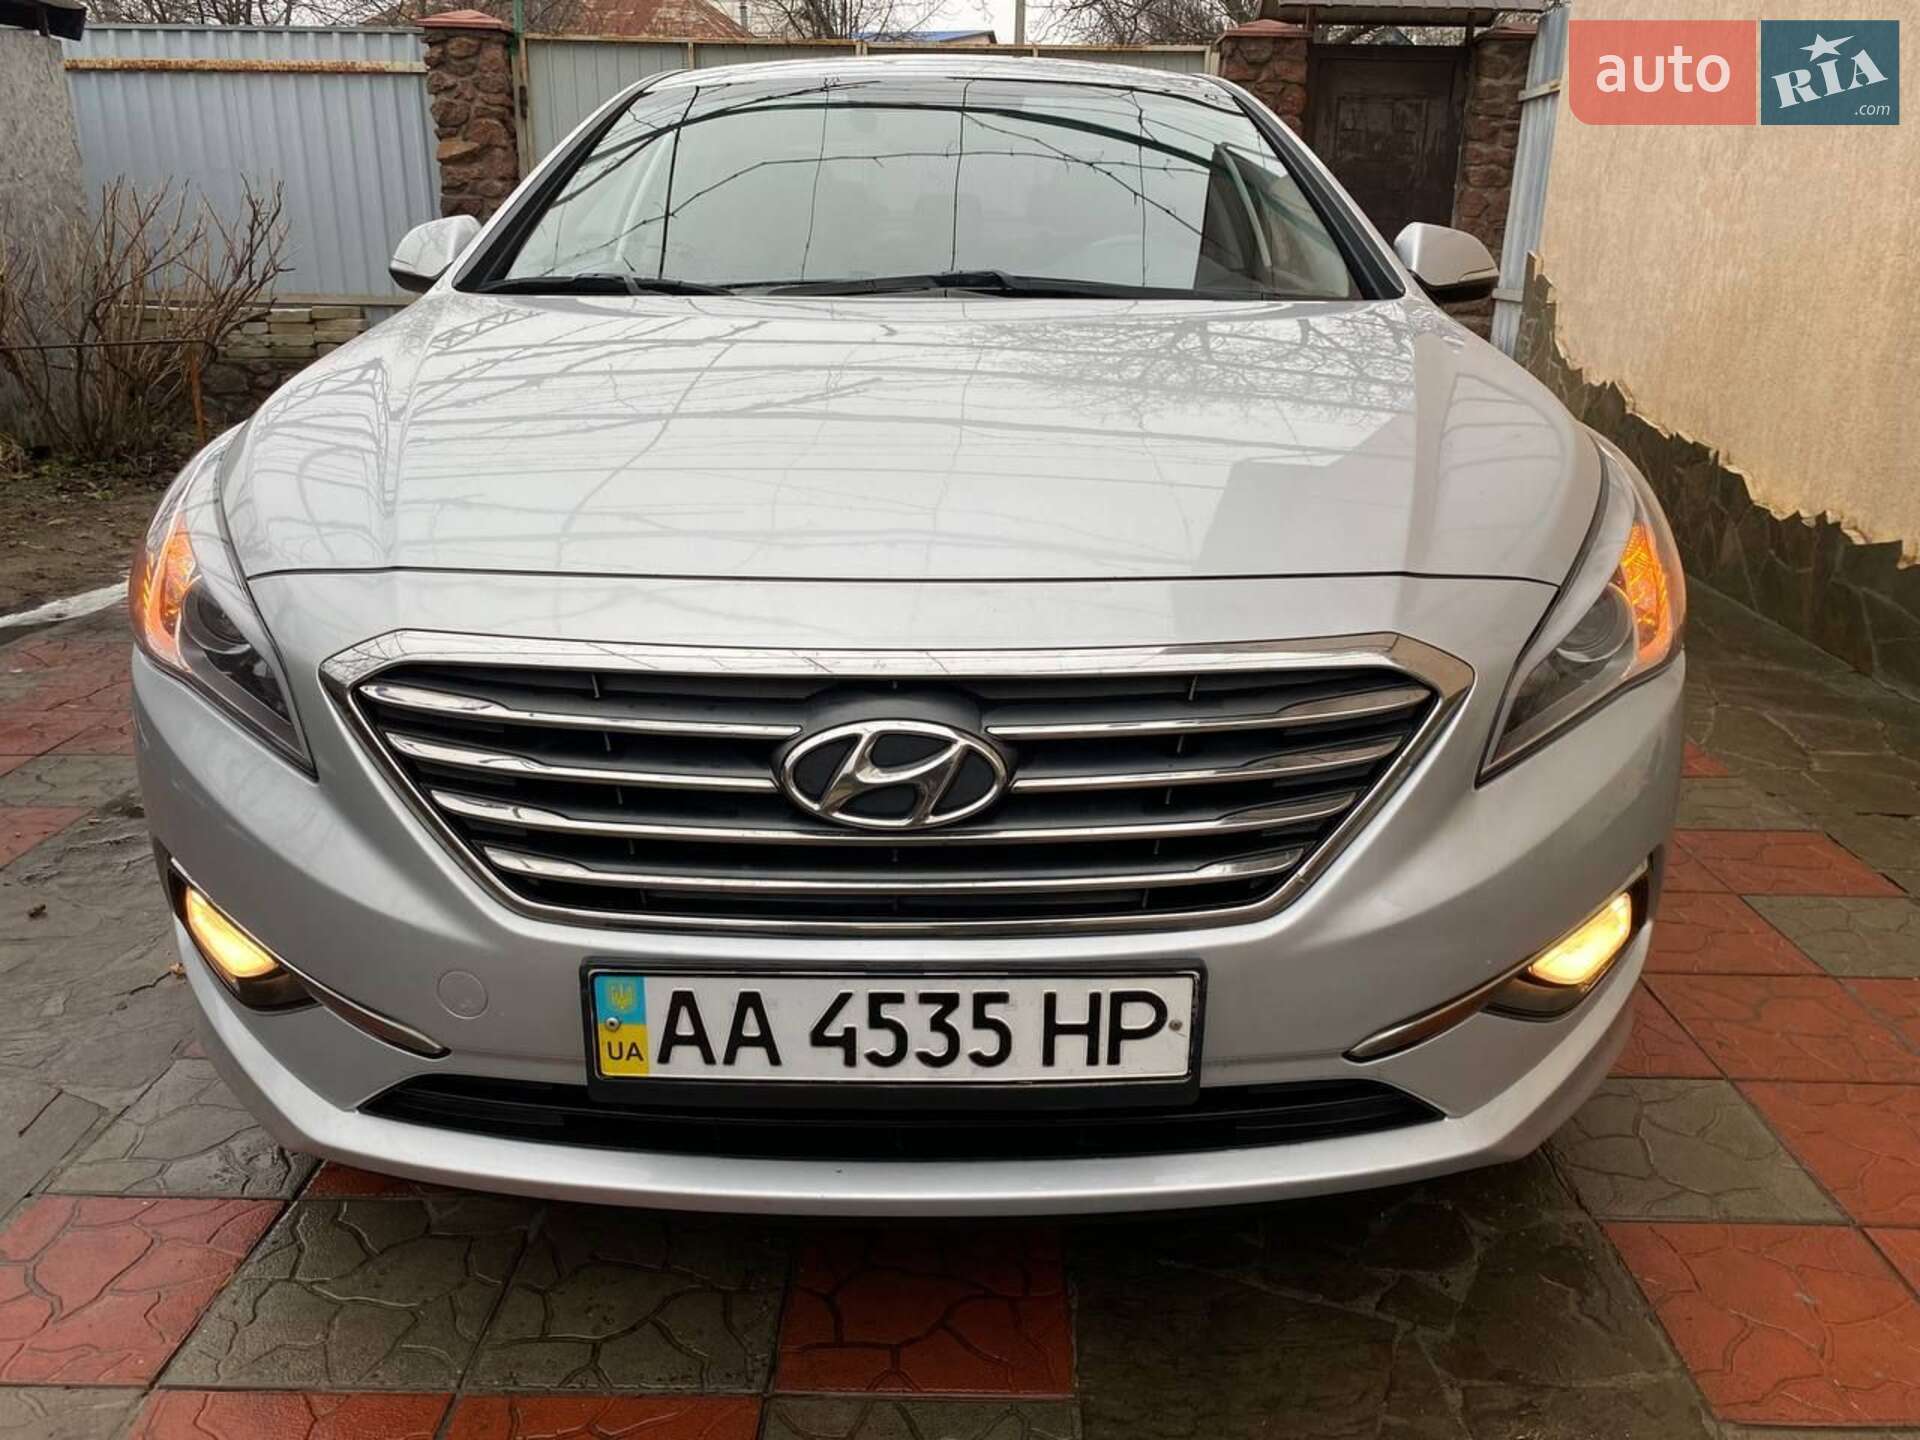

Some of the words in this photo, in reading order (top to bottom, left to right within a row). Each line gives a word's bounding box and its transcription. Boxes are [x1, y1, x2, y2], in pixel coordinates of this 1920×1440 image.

[607, 1040, 645, 1062] UA
[656, 988, 783, 1066] AA
[809, 990, 1013, 1068] 4535
[1041, 990, 1168, 1067] HP
